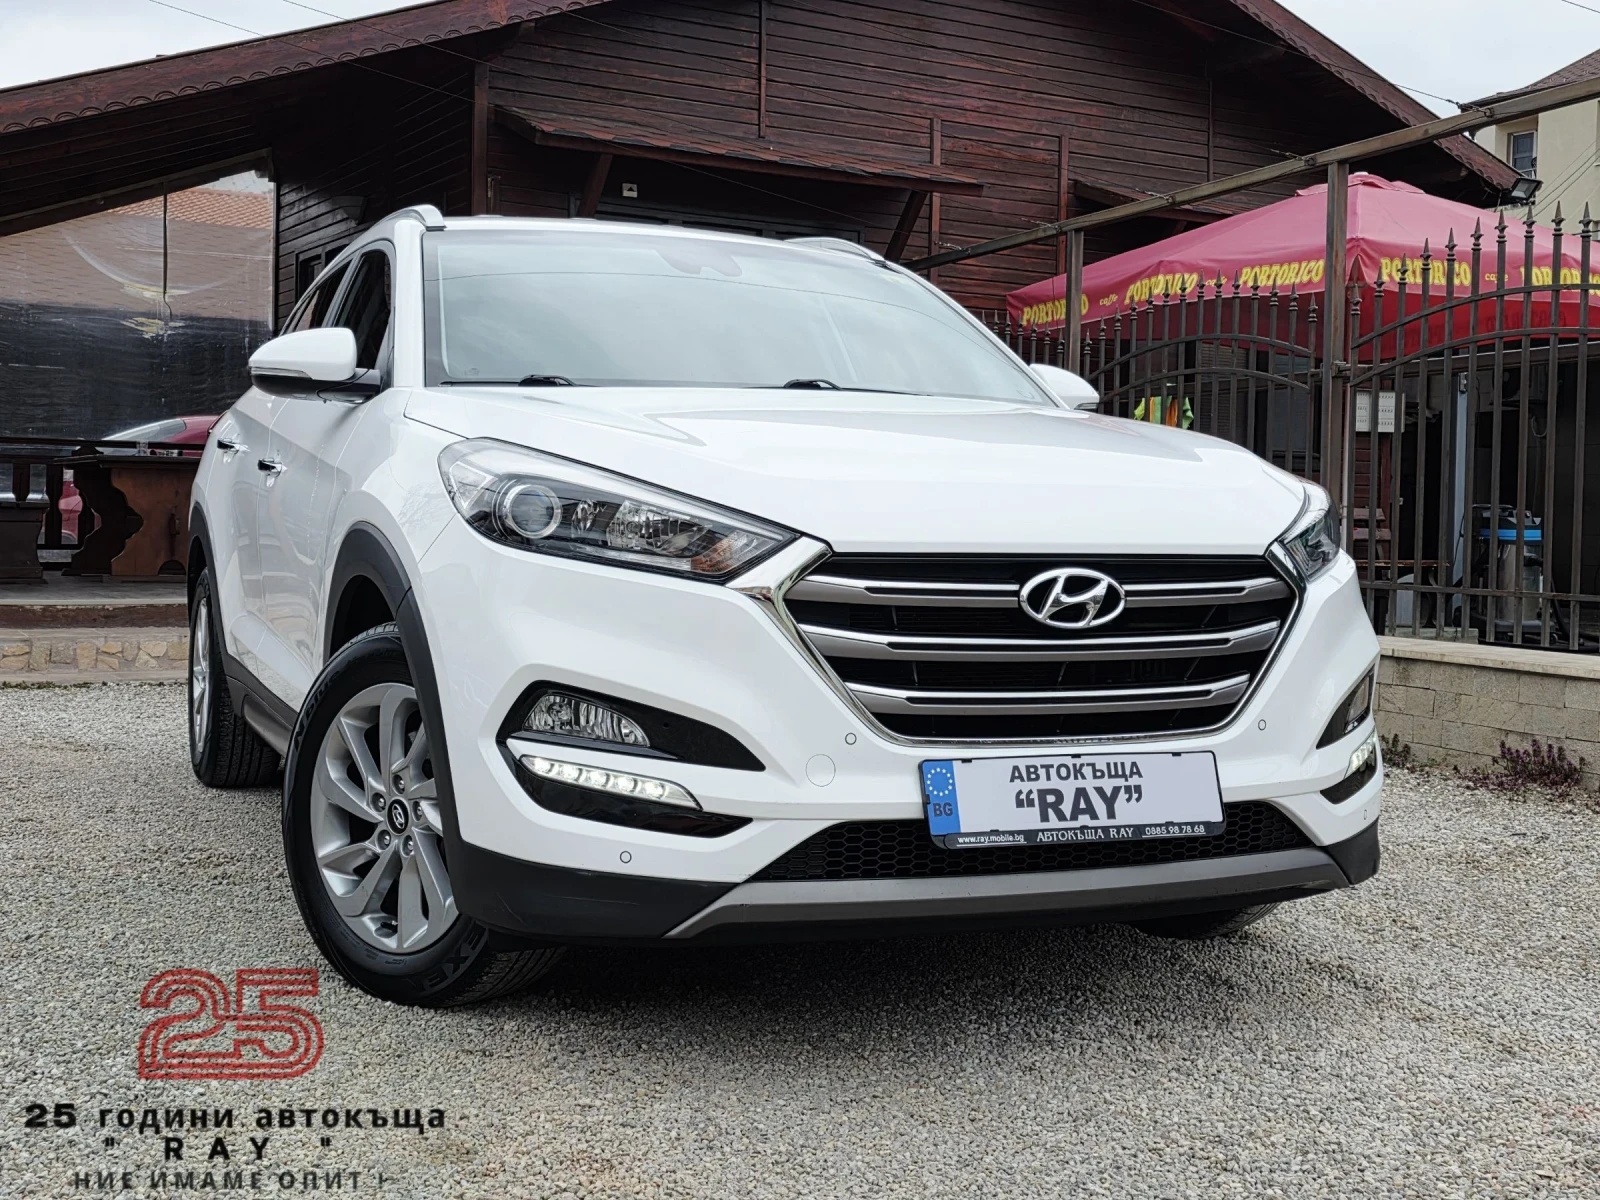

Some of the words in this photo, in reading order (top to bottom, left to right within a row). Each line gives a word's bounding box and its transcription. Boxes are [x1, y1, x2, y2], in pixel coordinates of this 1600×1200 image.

[1239, 258, 1325, 288] PORTORICO
[1009, 761, 1143, 783] АВТОКЪЩА
[933, 802, 954, 817] BG
[1037, 828, 1105, 842] АВТОКЪЩА
[1110, 827, 1134, 838] RAY
[1145, 826, 1167, 835] 0885
[1168, 825, 1180, 834] 98
[1181, 825, 1193, 834] 78
[1193, 824, 1205, 833] 68
[957, 833, 1025, 844] www.ray.mobile.bg
